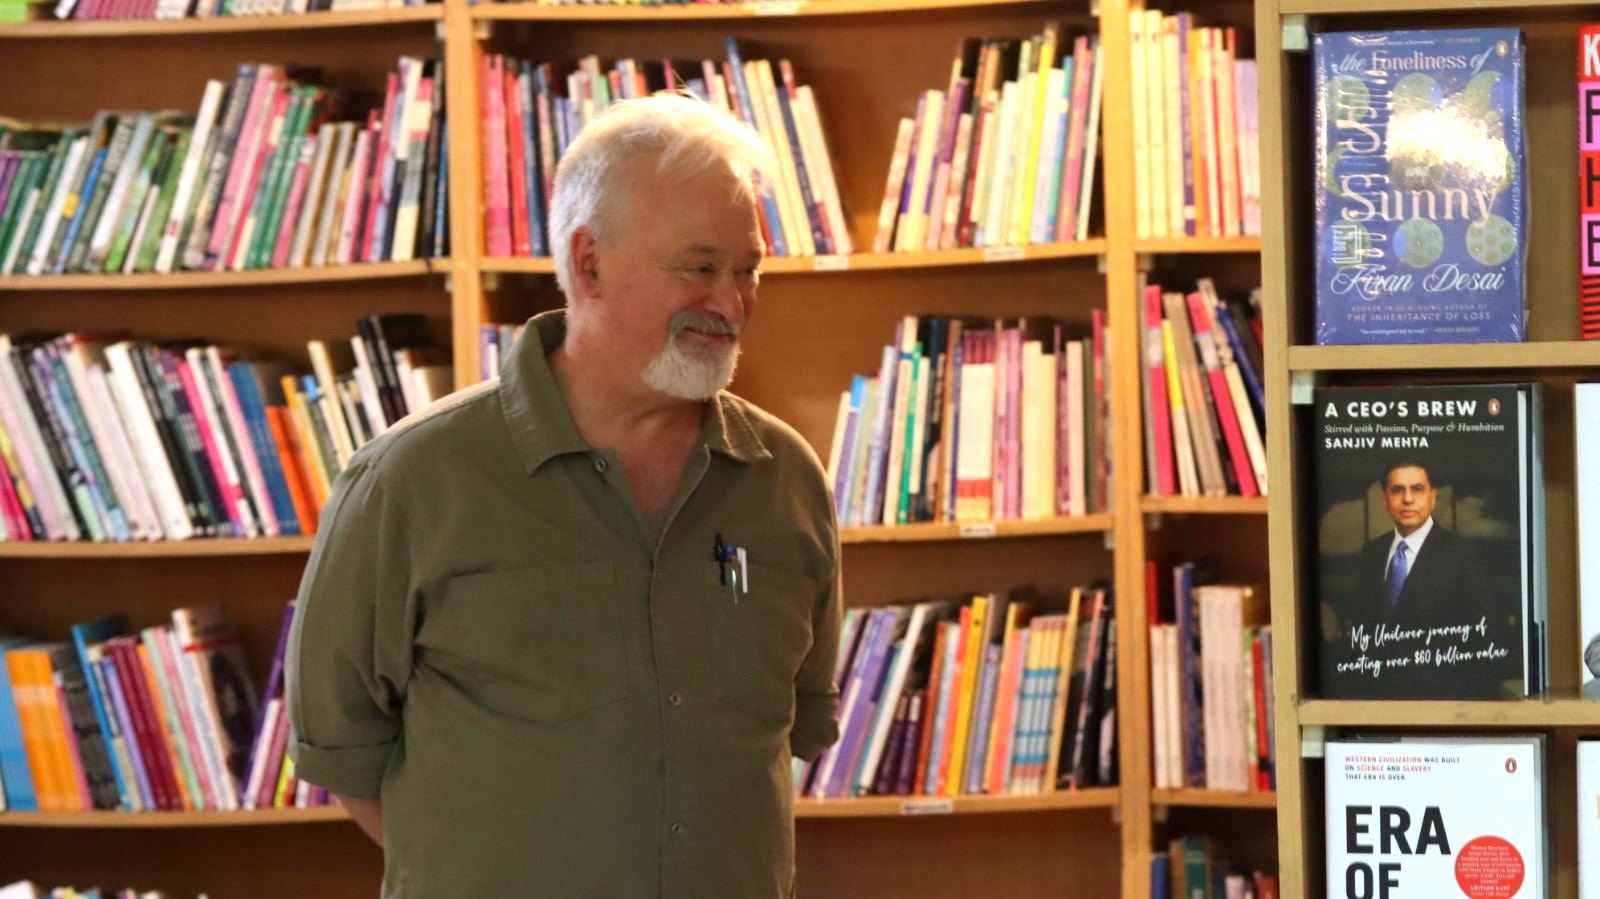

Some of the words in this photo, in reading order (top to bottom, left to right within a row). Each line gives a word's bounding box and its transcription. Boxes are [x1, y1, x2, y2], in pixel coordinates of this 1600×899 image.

[1340, 51, 1367, 73] the
[1369, 50, 1466, 71] Loneliness
[1469, 44, 1495, 76] of
[1341, 173, 1498, 229] Sunny
[1331, 266, 1413, 300] Kiran
[1422, 264, 1505, 293] Desai
[1346, 313, 1367, 322] THE
[1371, 312, 1441, 321] INHERITANCE
[1445, 312, 1460, 321] OF
[1463, 311, 1491, 321] LOSS
[1324, 402, 1339, 418] A
[1347, 401, 1409, 418] CEO'S
[1417, 400, 1478, 417] BREW
[1324, 423, 1353, 433] Stirred
[1354, 424, 1374, 433] with
[1375, 423, 1409, 433] Passion,
[1411, 423, 1444, 435] Purpose
[1446, 421, 1457, 432] &
[1457, 422, 1505, 432] Humbition
[1325, 437, 1376, 449] SANJIV
[1381, 436, 1430, 449] MEHTA
[1351, 623, 1371, 652] My
[1374, 623, 1424, 648] Unilever
[1425, 624, 1470, 646] journey
[1474, 615, 1487, 638] of
[1337, 653, 1383, 678] creating
[1386, 655, 1411, 669] over
[1414, 649, 1431, 666] $60
[1433, 645, 1472, 668] billion
[1474, 642, 1508, 661] value
[1345, 804, 1452, 856] ERA
[1345, 861, 1402, 899] OF
